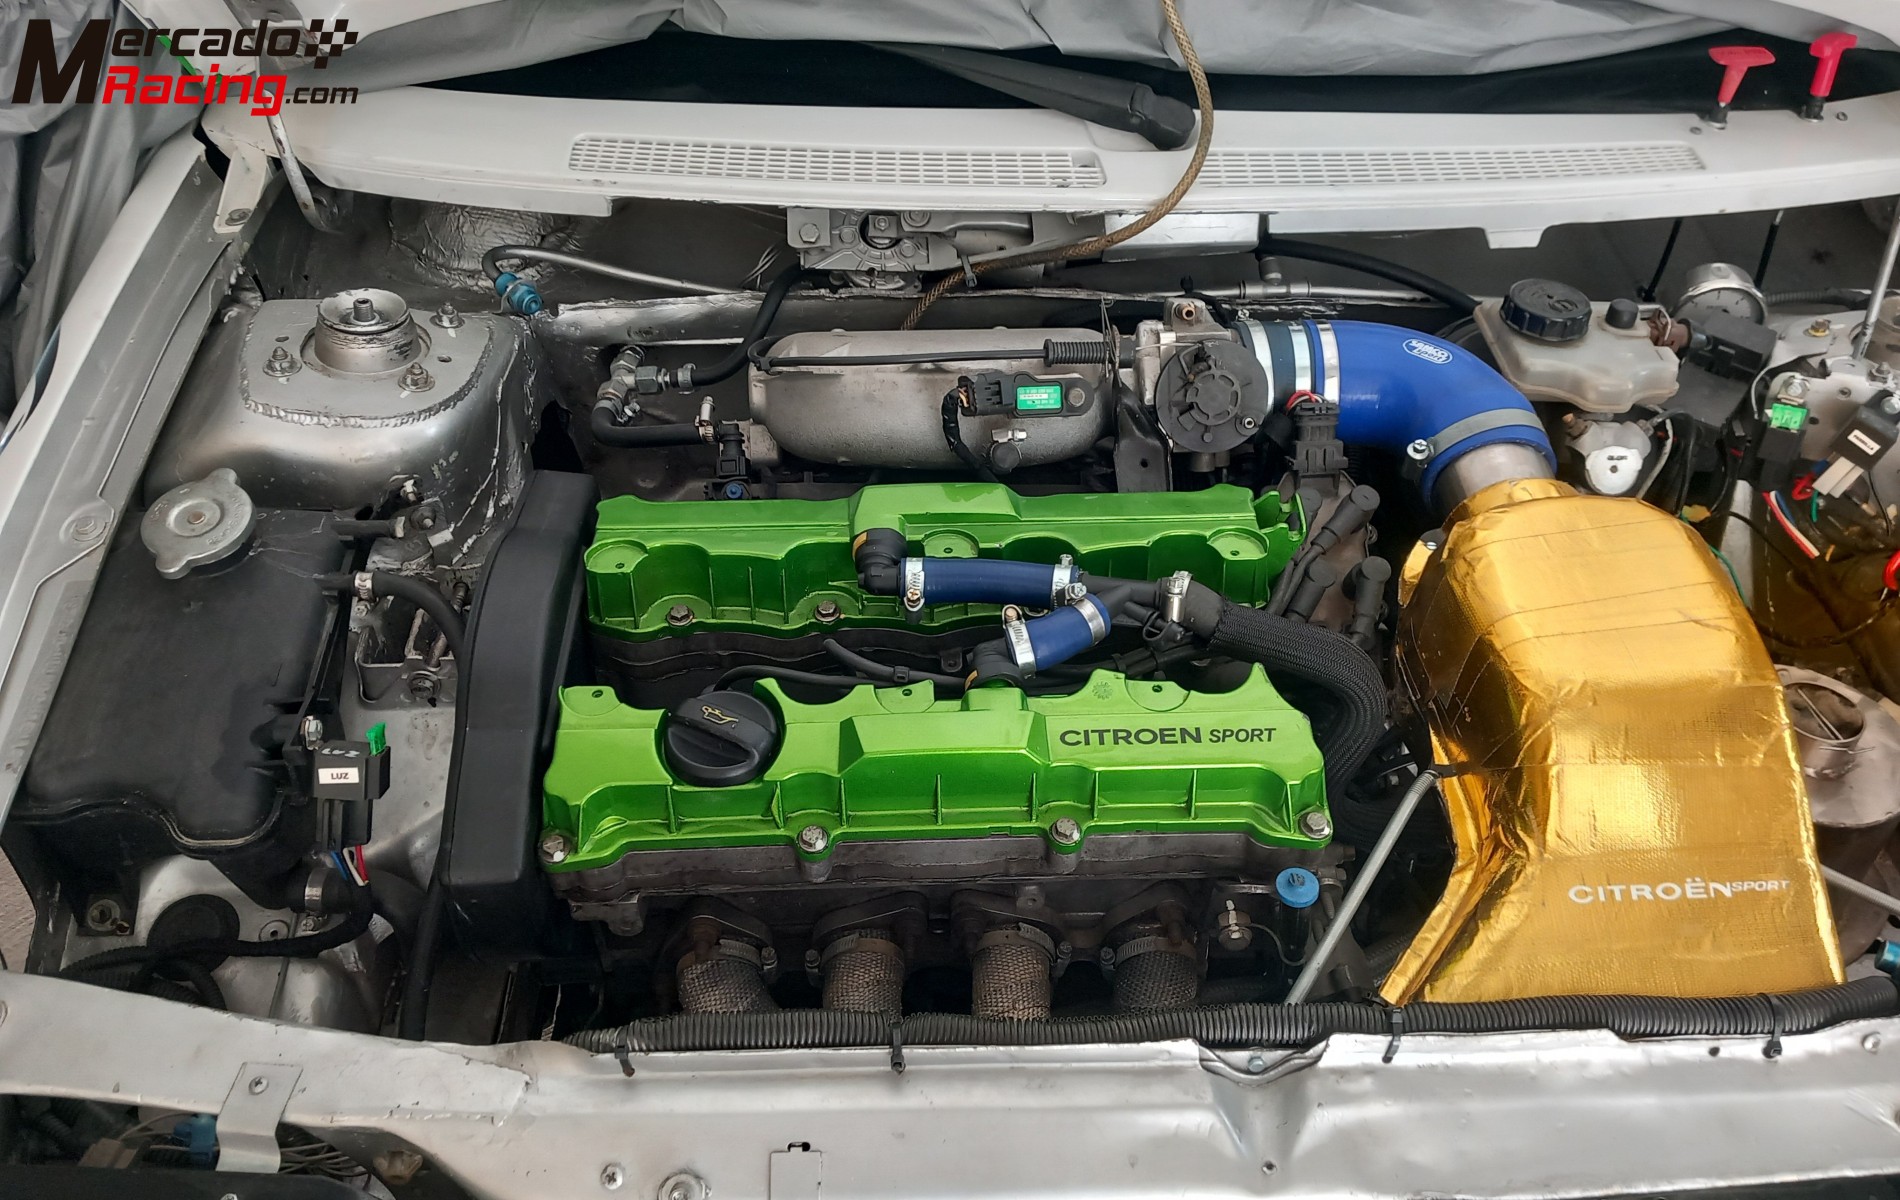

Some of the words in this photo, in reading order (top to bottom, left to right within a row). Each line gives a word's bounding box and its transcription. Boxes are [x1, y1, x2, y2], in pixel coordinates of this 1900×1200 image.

[1059, 727, 1202, 746] CITROEN
[1208, 727, 1277, 743] SPORT
[330, 772, 350, 780] LUZ
[1567, 877, 1733, 904] CITROËN
[1731, 879, 1790, 892] SPORT
